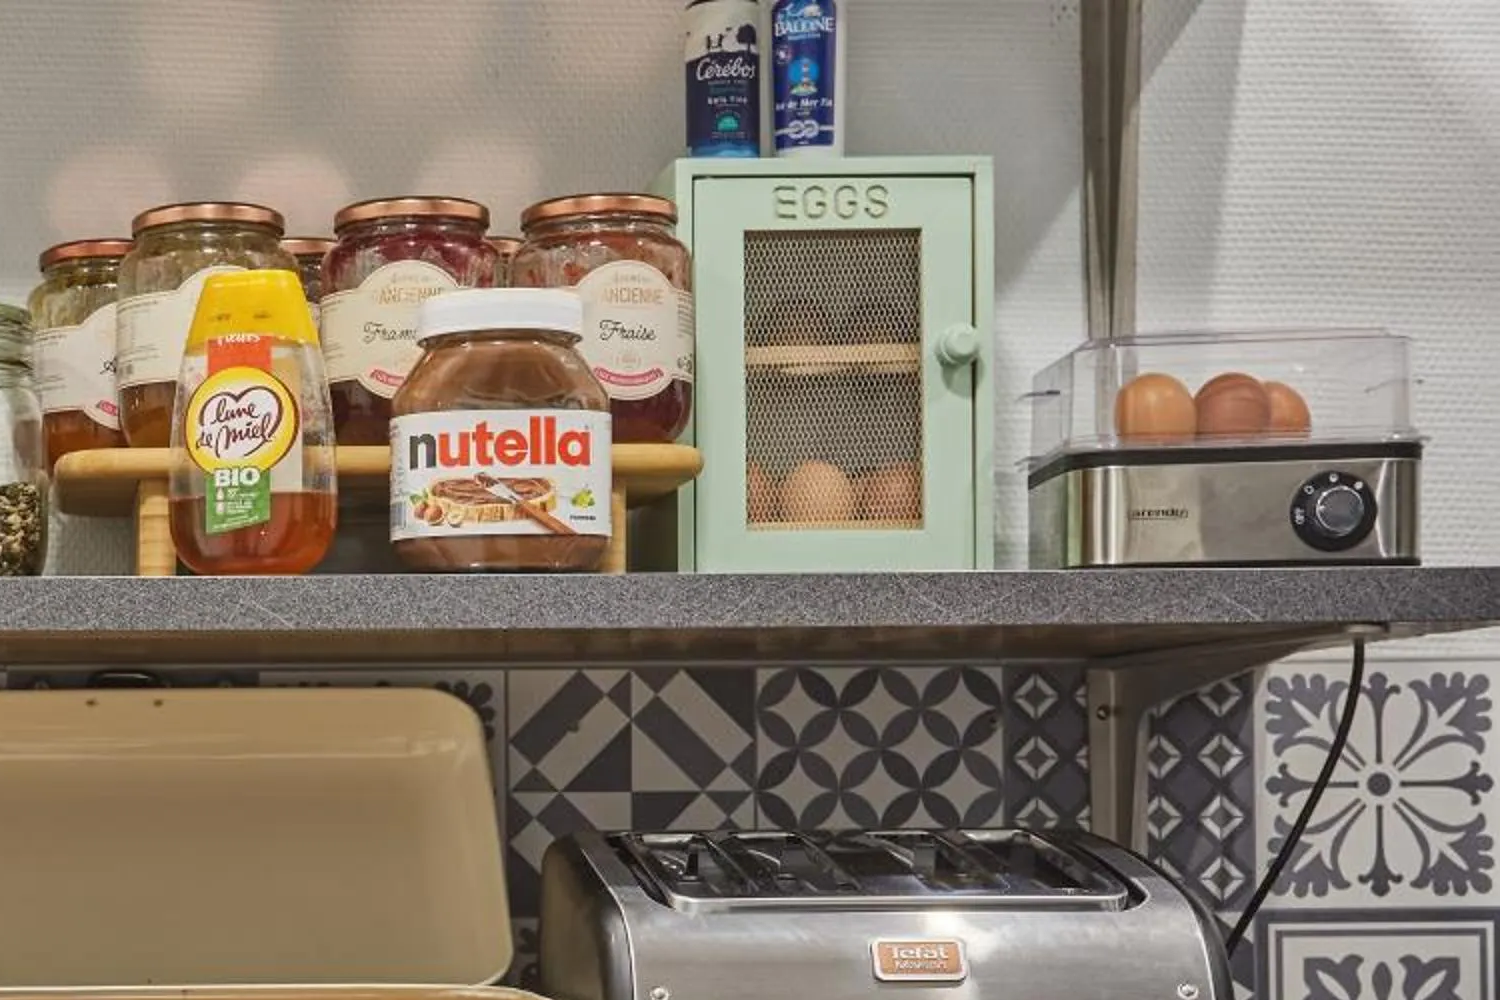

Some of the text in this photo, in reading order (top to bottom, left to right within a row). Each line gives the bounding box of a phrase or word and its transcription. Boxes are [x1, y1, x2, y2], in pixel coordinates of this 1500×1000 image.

[773, 184, 889, 220] EGGS
[599, 319, 657, 341] Fraise
[409, 415, 591, 470] nutella
[215, 466, 261, 487] BIO
[891, 945, 949, 959] Tefal
